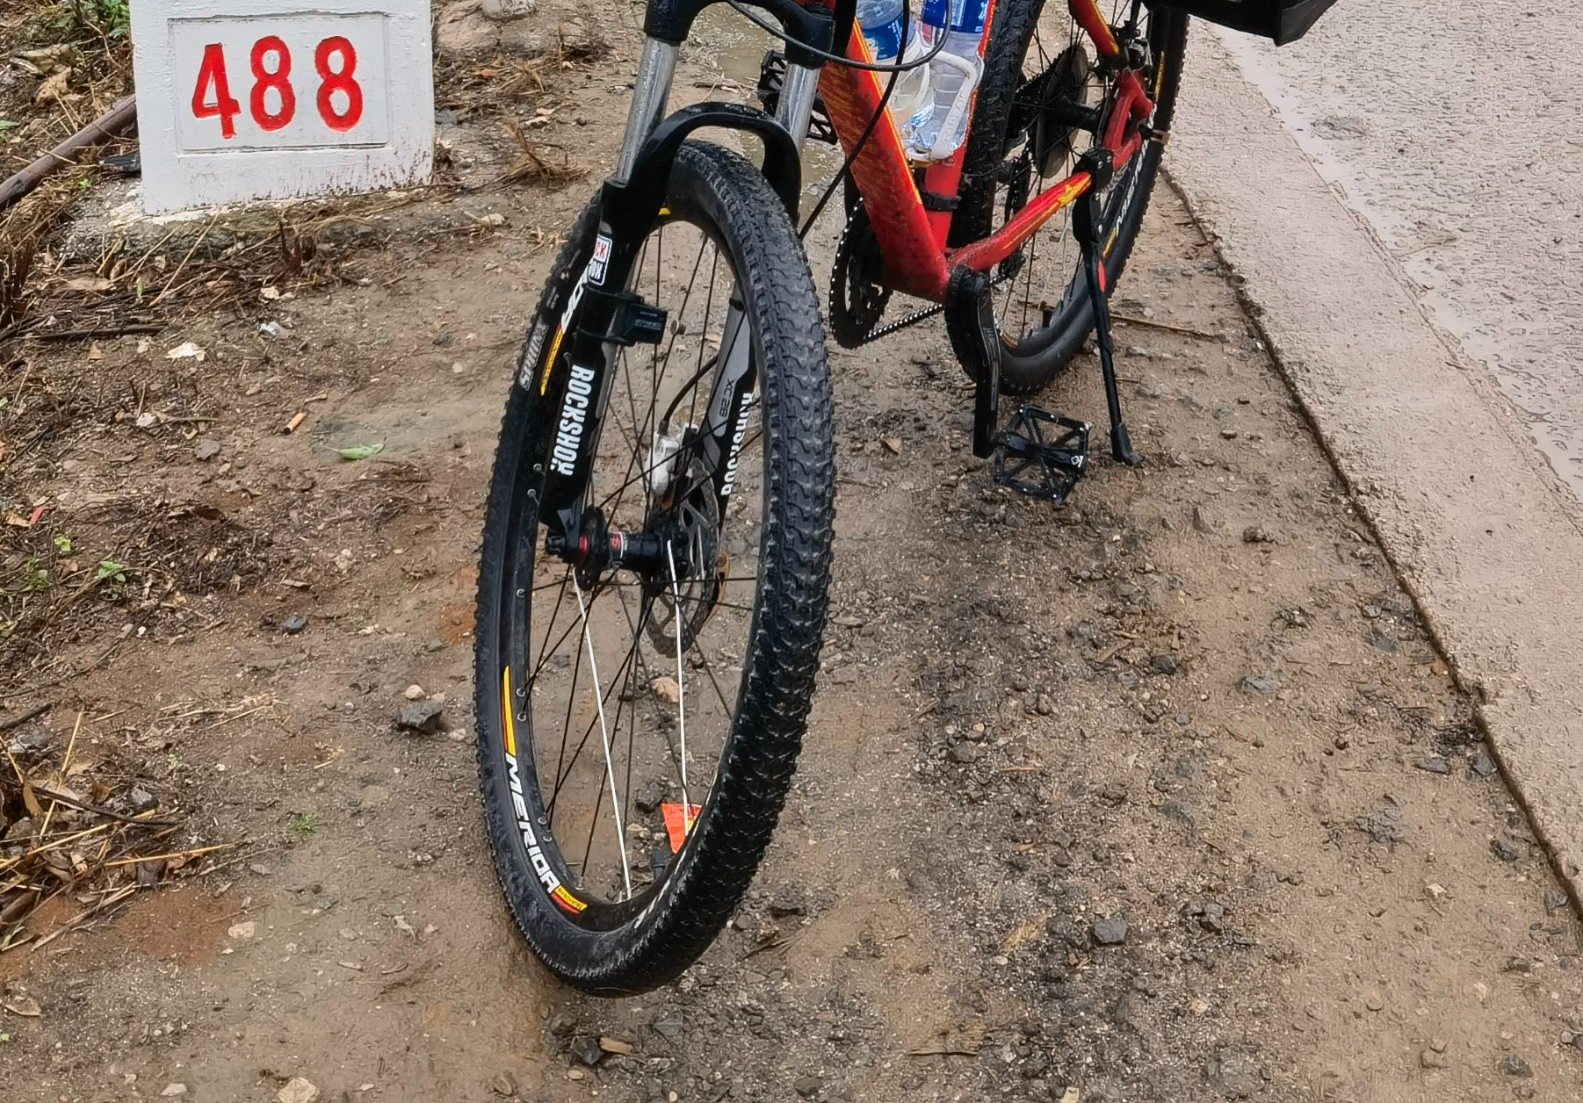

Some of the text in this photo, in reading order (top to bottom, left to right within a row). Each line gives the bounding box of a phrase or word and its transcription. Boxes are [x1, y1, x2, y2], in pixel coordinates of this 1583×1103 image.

[191, 35, 364, 140] 488
[550, 364, 596, 476] ROCKSHOX
[505, 755, 561, 894] MERIDA
